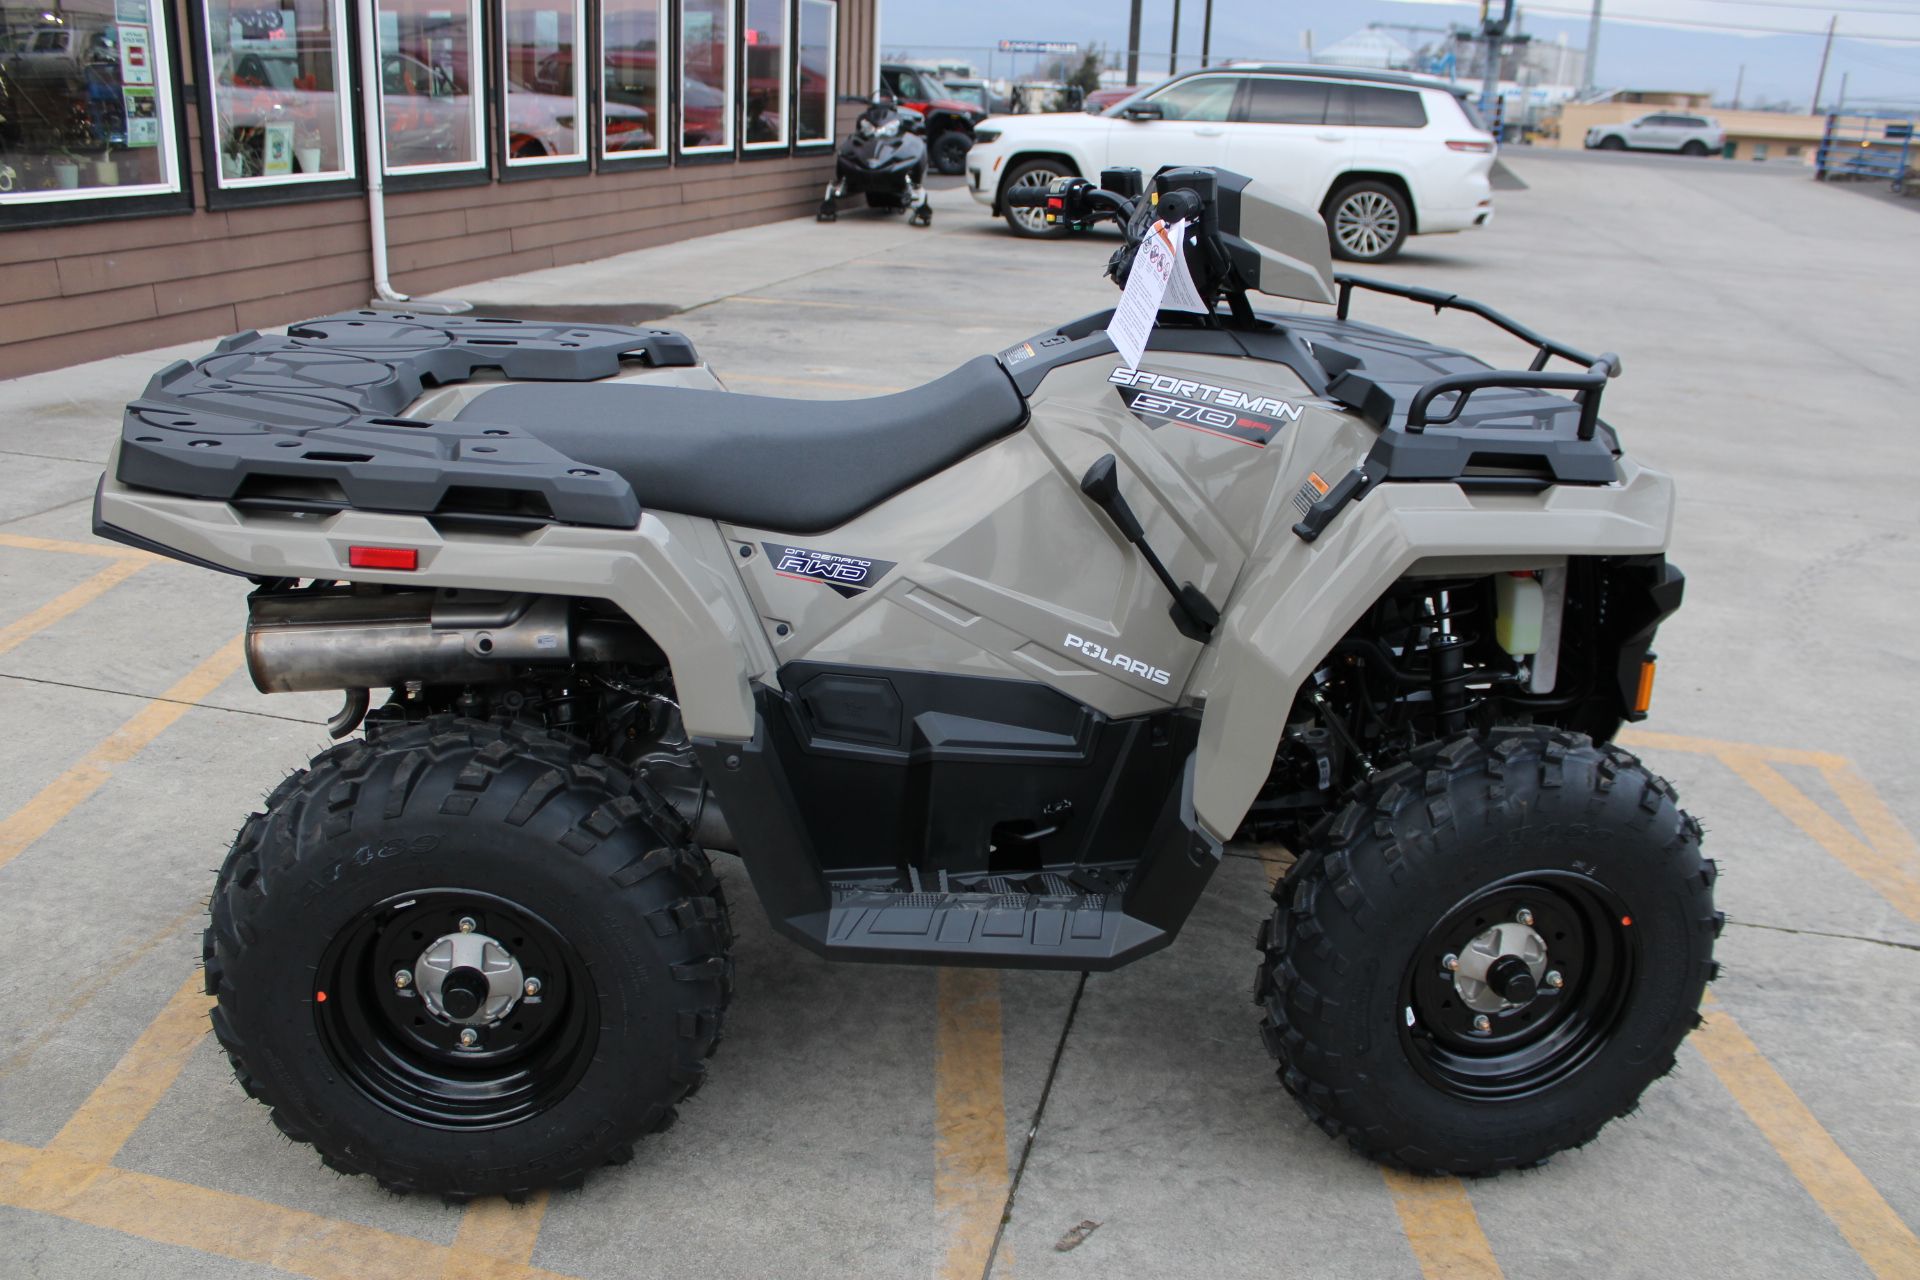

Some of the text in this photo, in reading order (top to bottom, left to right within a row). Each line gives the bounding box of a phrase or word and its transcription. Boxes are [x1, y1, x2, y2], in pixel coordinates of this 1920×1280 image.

[1107, 367, 1305, 422] SPORTSMAN
[1130, 393, 1237, 428] 570
[777, 555, 867, 582] AWD
[784, 548, 872, 567] ON DEMAND
[1063, 633, 1171, 685] POLARIS
